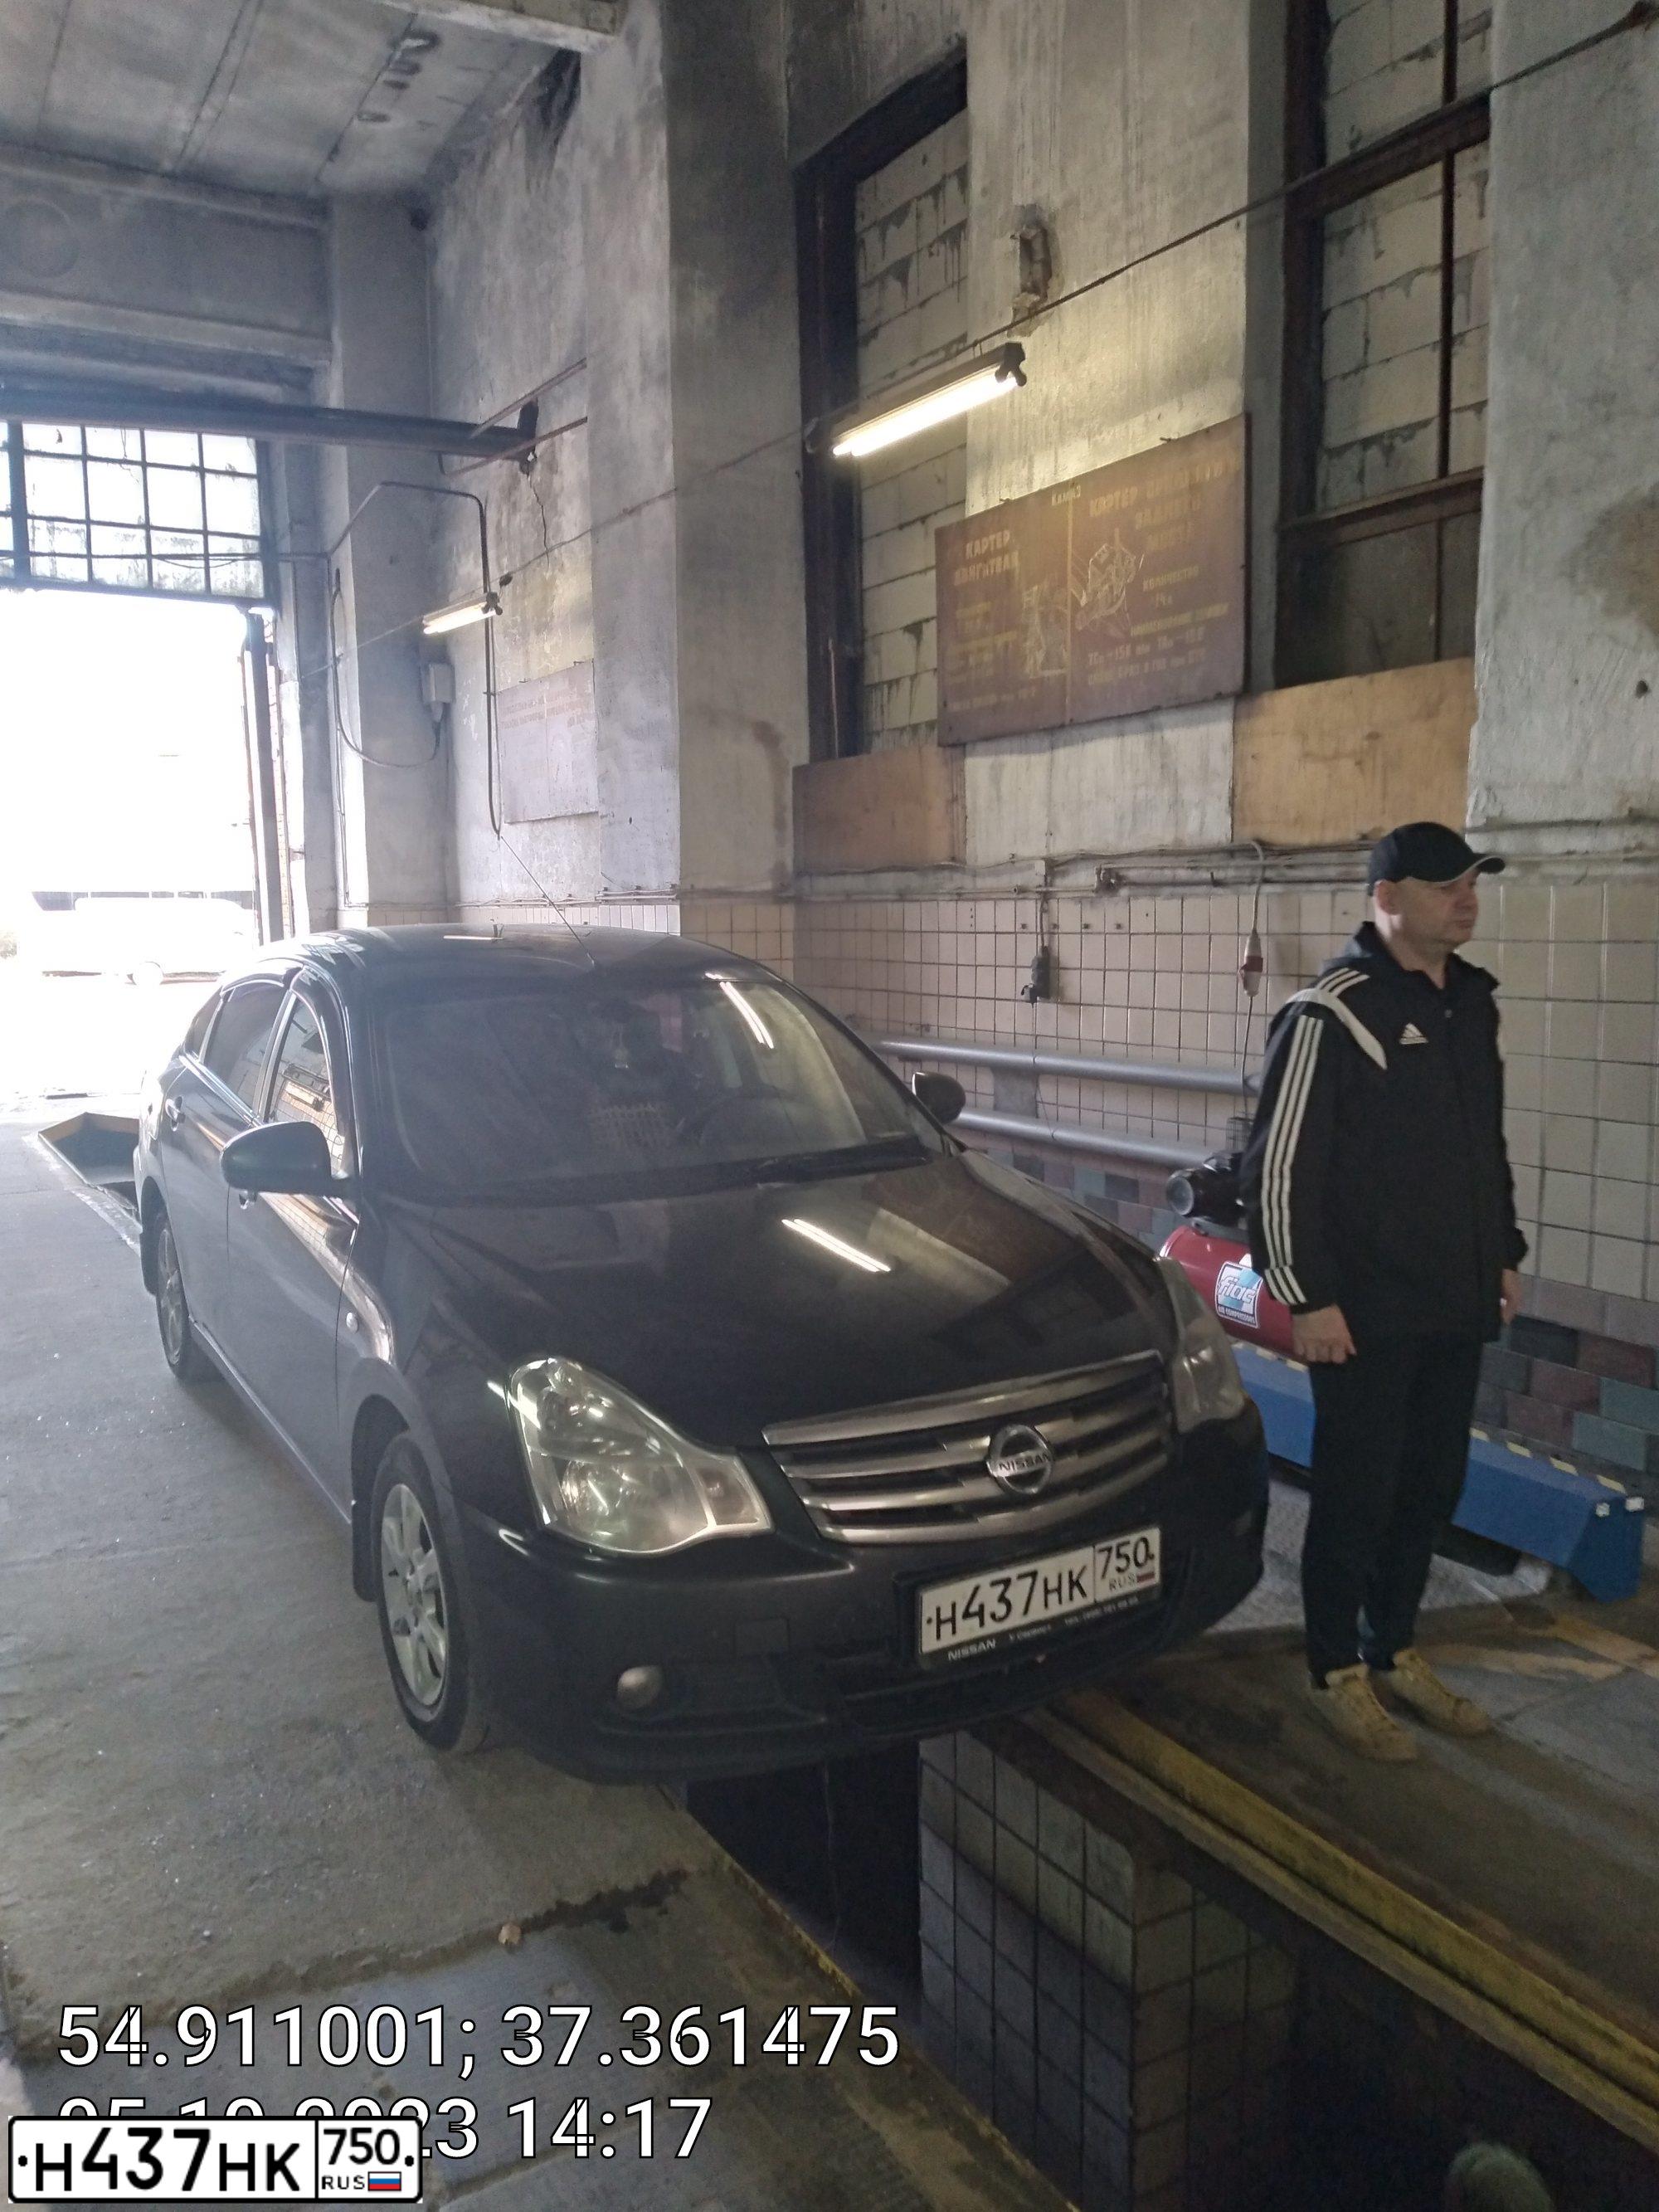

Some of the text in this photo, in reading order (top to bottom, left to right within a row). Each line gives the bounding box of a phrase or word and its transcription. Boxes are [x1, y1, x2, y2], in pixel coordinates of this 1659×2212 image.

[965, 529, 1011, 559] КАРТЕР
[1218, 1274, 1257, 1303] fiac
[999, 1453, 1048, 1471] NISSAN
[934, 1564, 1088, 1642] Н437НК
[1097, 1537, 1150, 1581] 750
[1108, 1573, 1137, 1591] RUS
[947, 1639, 997, 1661] NISSAN
